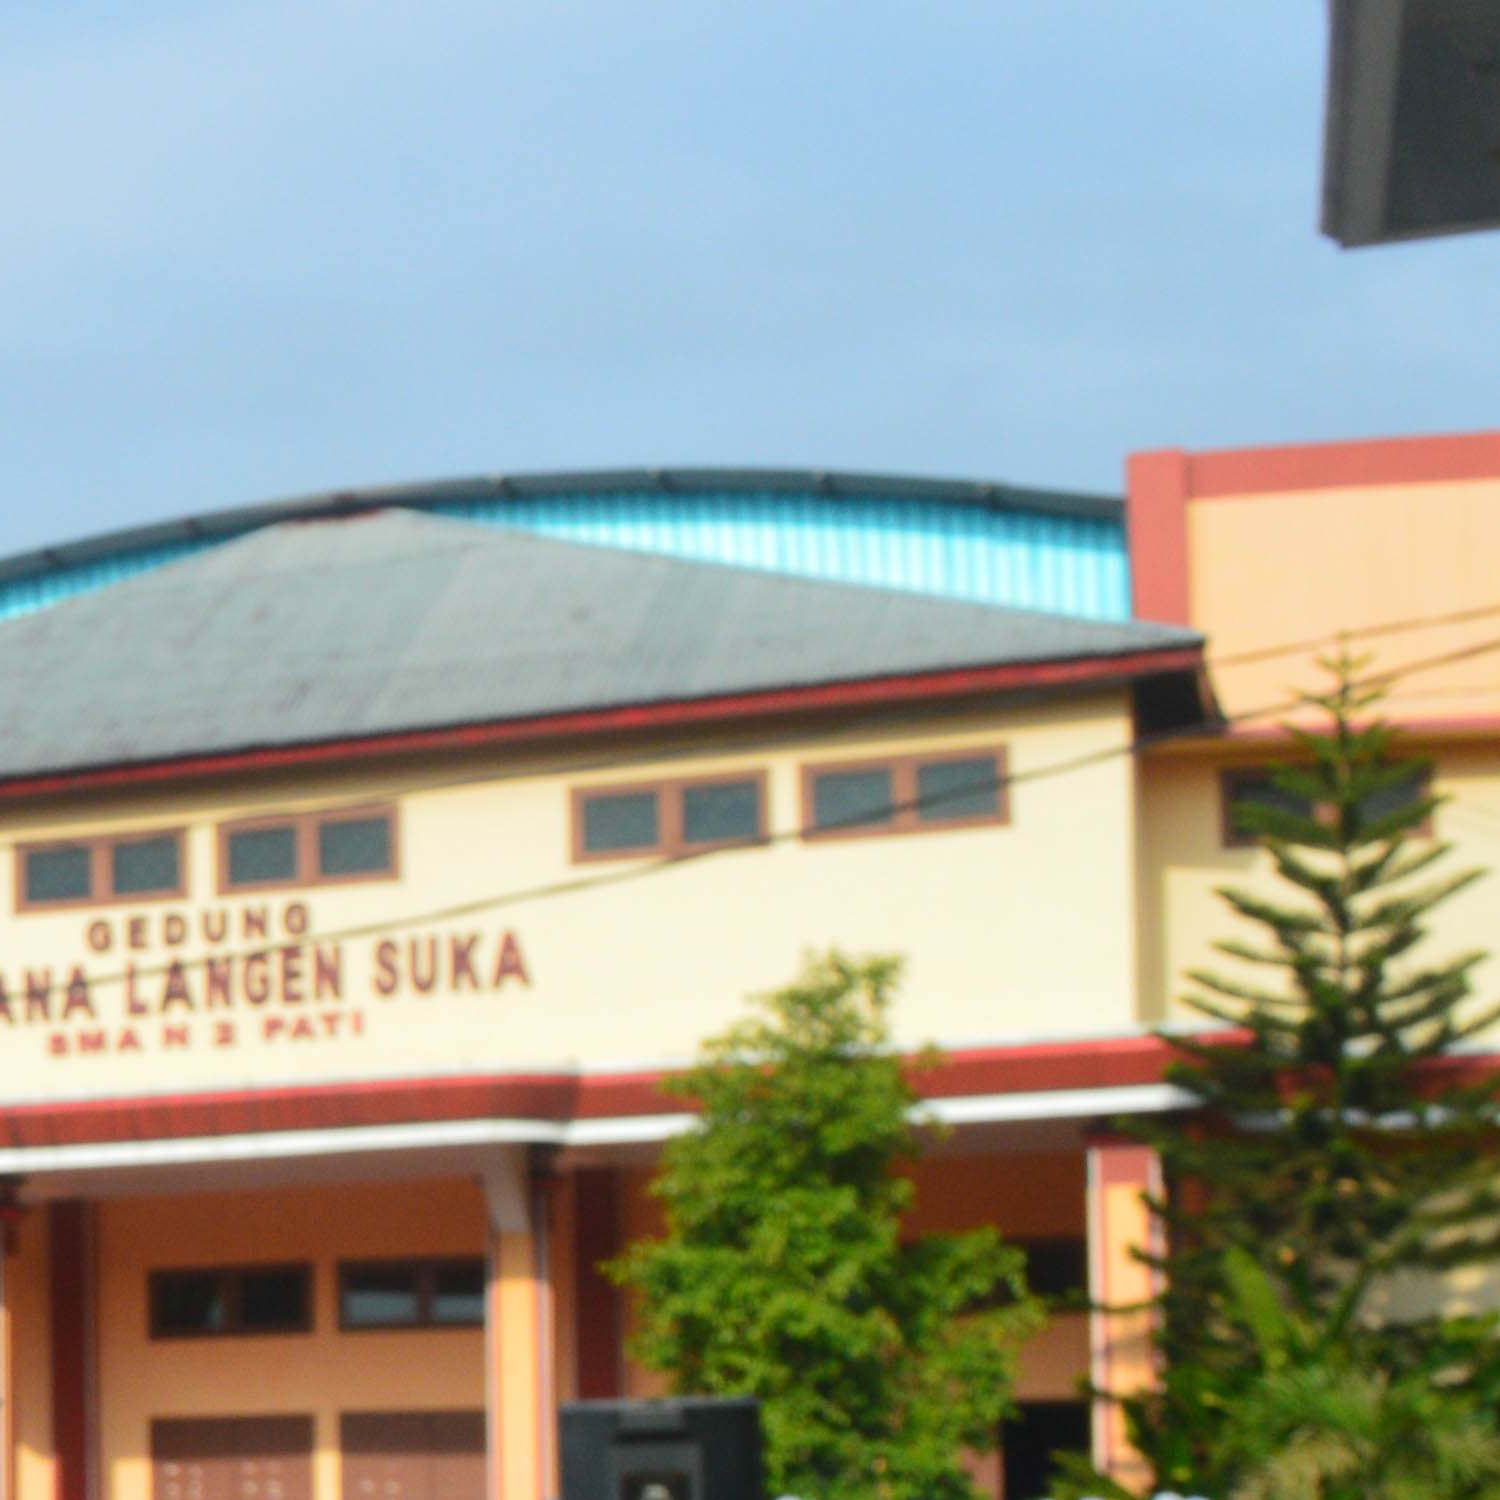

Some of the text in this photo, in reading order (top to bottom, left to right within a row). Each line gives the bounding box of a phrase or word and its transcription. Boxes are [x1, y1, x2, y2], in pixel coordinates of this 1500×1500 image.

[125, 942, 344, 1016] LANGEN
[372, 931, 532, 997] SUKA
[262, 1009, 366, 1040] PATI
